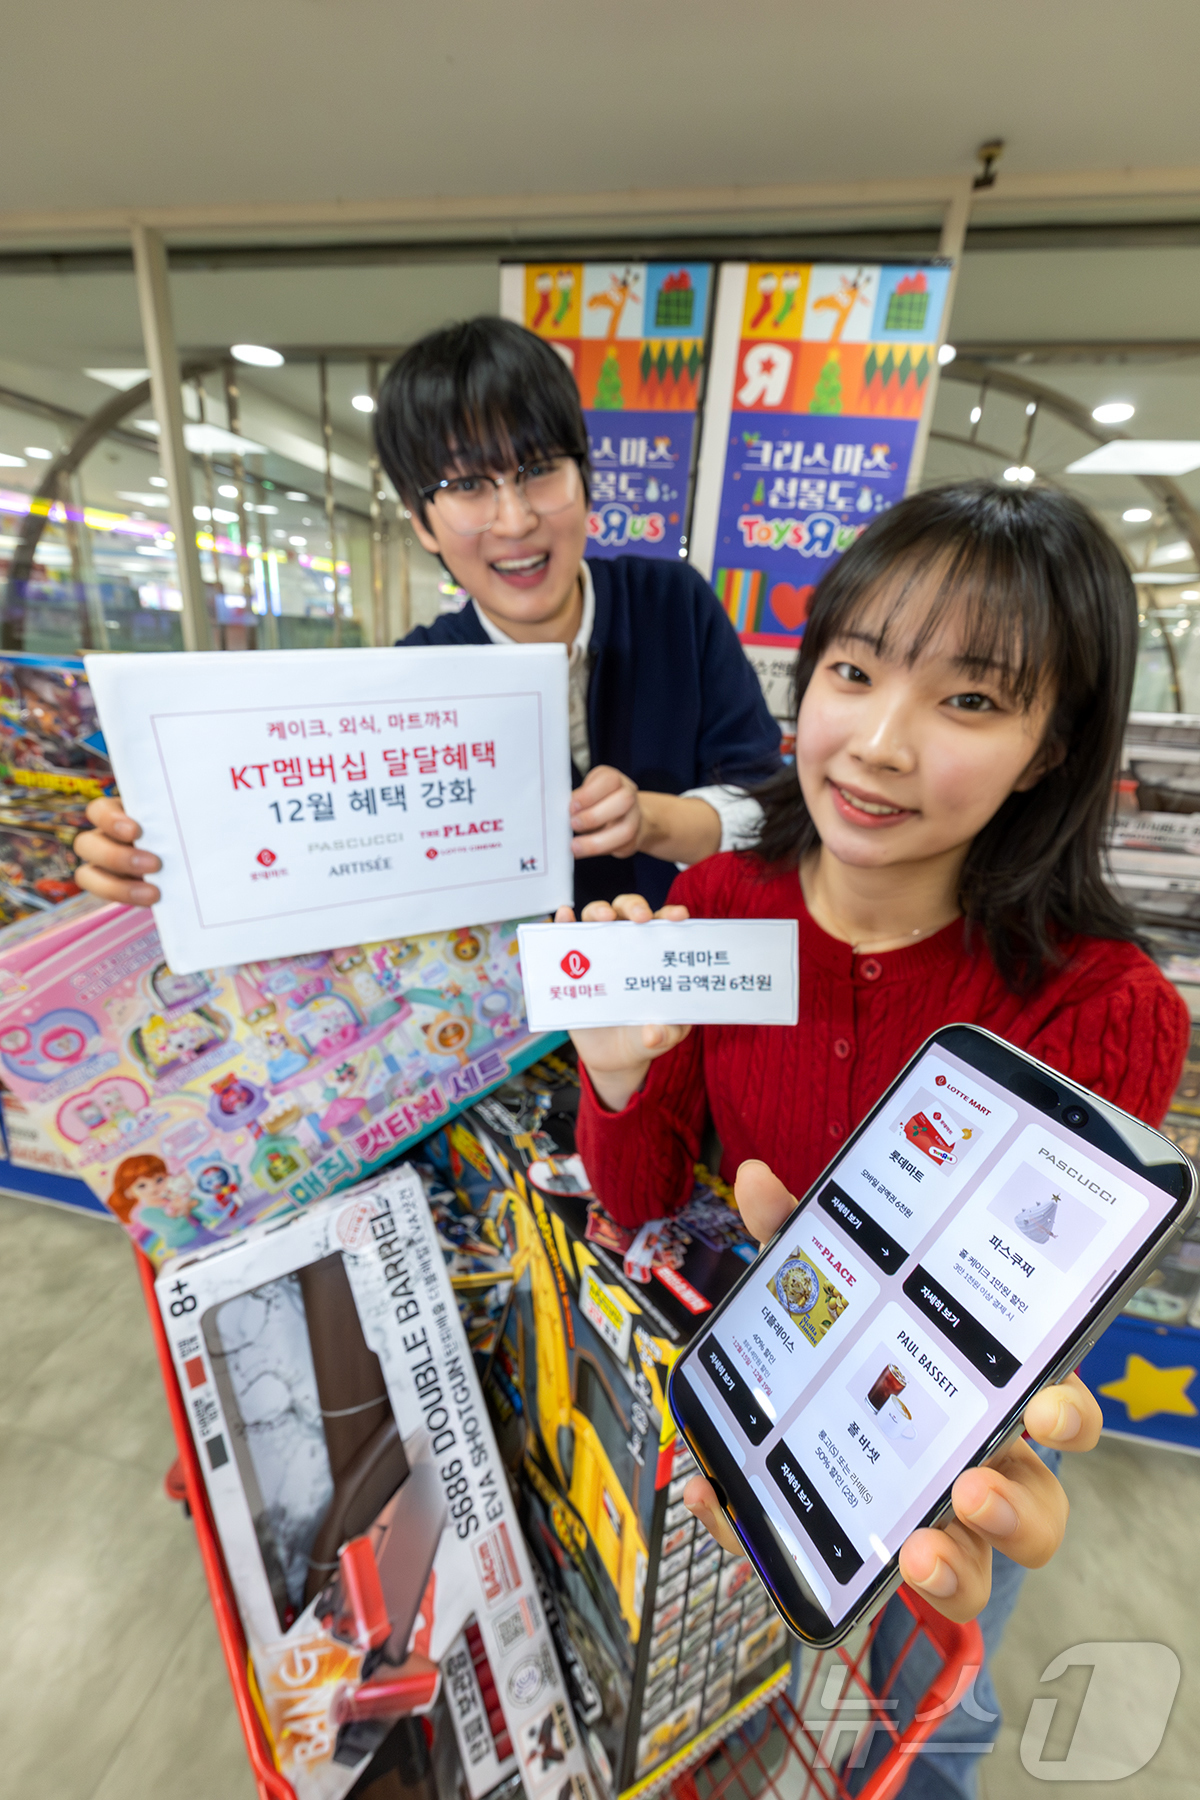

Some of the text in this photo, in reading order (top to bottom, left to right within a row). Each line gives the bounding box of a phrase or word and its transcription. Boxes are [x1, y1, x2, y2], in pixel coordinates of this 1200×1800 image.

[741, 439, 891, 479] 크리스마스
[768, 477, 857, 512] 선물도
[267, 709, 459, 740] 케이크, 외식, 마트까지
[230, 740, 497, 790] KT멤버십 달달혜택
[269, 777, 477, 824] 12월 혜택 강화
[307, 832, 405, 855] PASCUCCI
[443, 818, 504, 839] PLACE
[328, 856, 394, 878] ARTISÉE
[519, 856, 537, 873] kt
[662, 950, 730, 968] 롯데마트
[549, 983, 608, 1000] 롯데마트
[624, 974, 772, 992] 모바일 금액권 6천원
[354, 1086, 445, 1159] 캣타워
[451, 1051, 507, 1099] 세트
[947, 1084, 992, 1117] LOTTE MART
[889, 1149, 925, 1183] 롯데마트
[1038, 1147, 1117, 1205] PASCUCCI
[831, 1196, 863, 1229] 자세히 보기
[860, 1168, 914, 1219] 모바일 금액권 6천원
[811, 1235, 858, 1288] THE PLACE
[989, 1234, 1035, 1278] 파스쿠찌
[953, 1263, 1015, 1322] 3만 1천원 이상 결제 시
[958, 1248, 1029, 1314] 홀 케이크 1만원 할인
[920, 1285, 961, 1328] 자세히 보기
[752, 1333, 777, 1365] 40% 할인
[760, 1306, 795, 1353] 더플레이스
[798, 1320, 818, 1345] Limone
[369, 1198, 480, 1540] S686 DOUBLE BARREL
[709, 1352, 736, 1392] 자세히 보기
[732, 1338, 744, 1354] 12월
[752, 1368, 764, 1384] 12월
[896, 1329, 959, 1399] PAUL BASSETT
[445, 1354, 489, 1468] SHOTGUN
[847, 1420, 880, 1465] 폴 바셋
[780, 1462, 814, 1513] 자세히 보기
[814, 1446, 859, 1508] 50% 할인 (2장)
[818, 1429, 874, 1505] 룽고(S) 또는 라떼(S)
[479, 1467, 504, 1524] EVA
